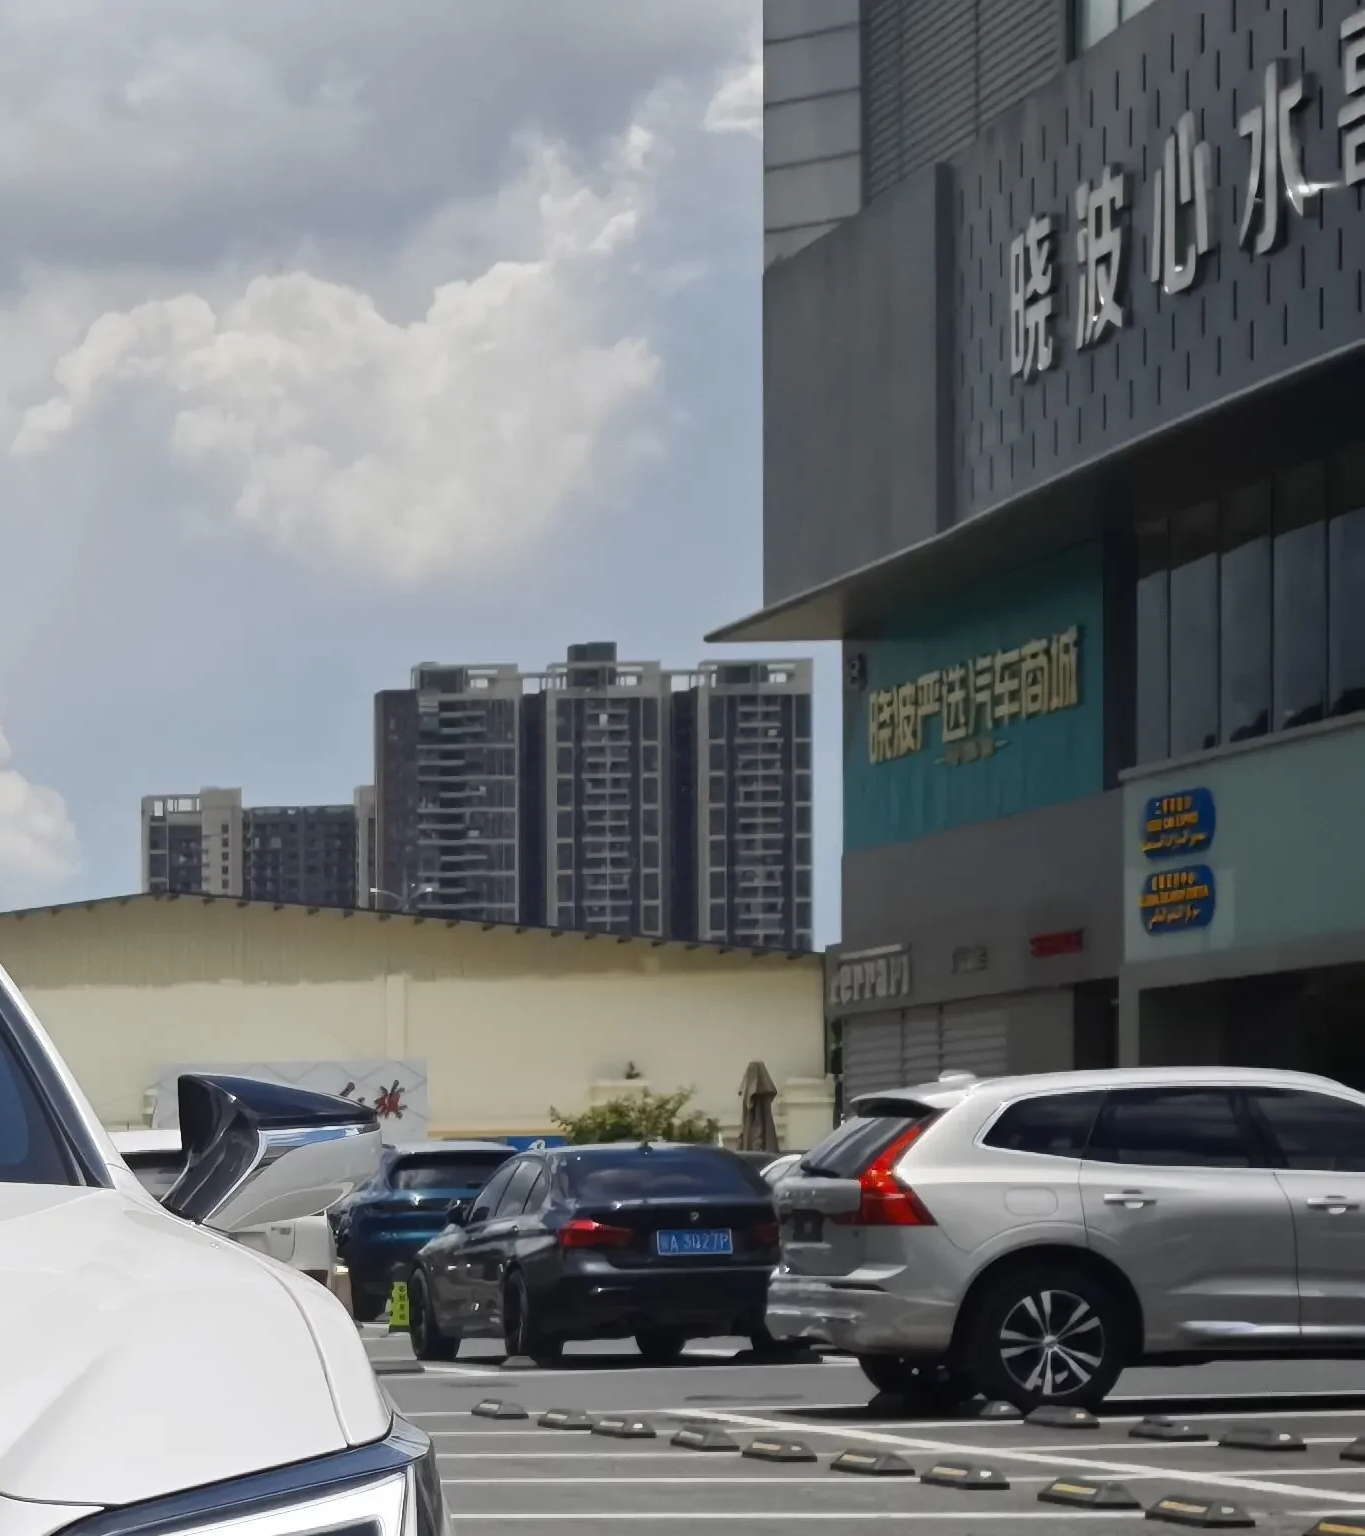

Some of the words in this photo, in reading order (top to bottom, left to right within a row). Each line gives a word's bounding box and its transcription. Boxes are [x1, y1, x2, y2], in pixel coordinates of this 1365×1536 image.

[870, 625, 1077, 765] 晓波严选汽车商城
